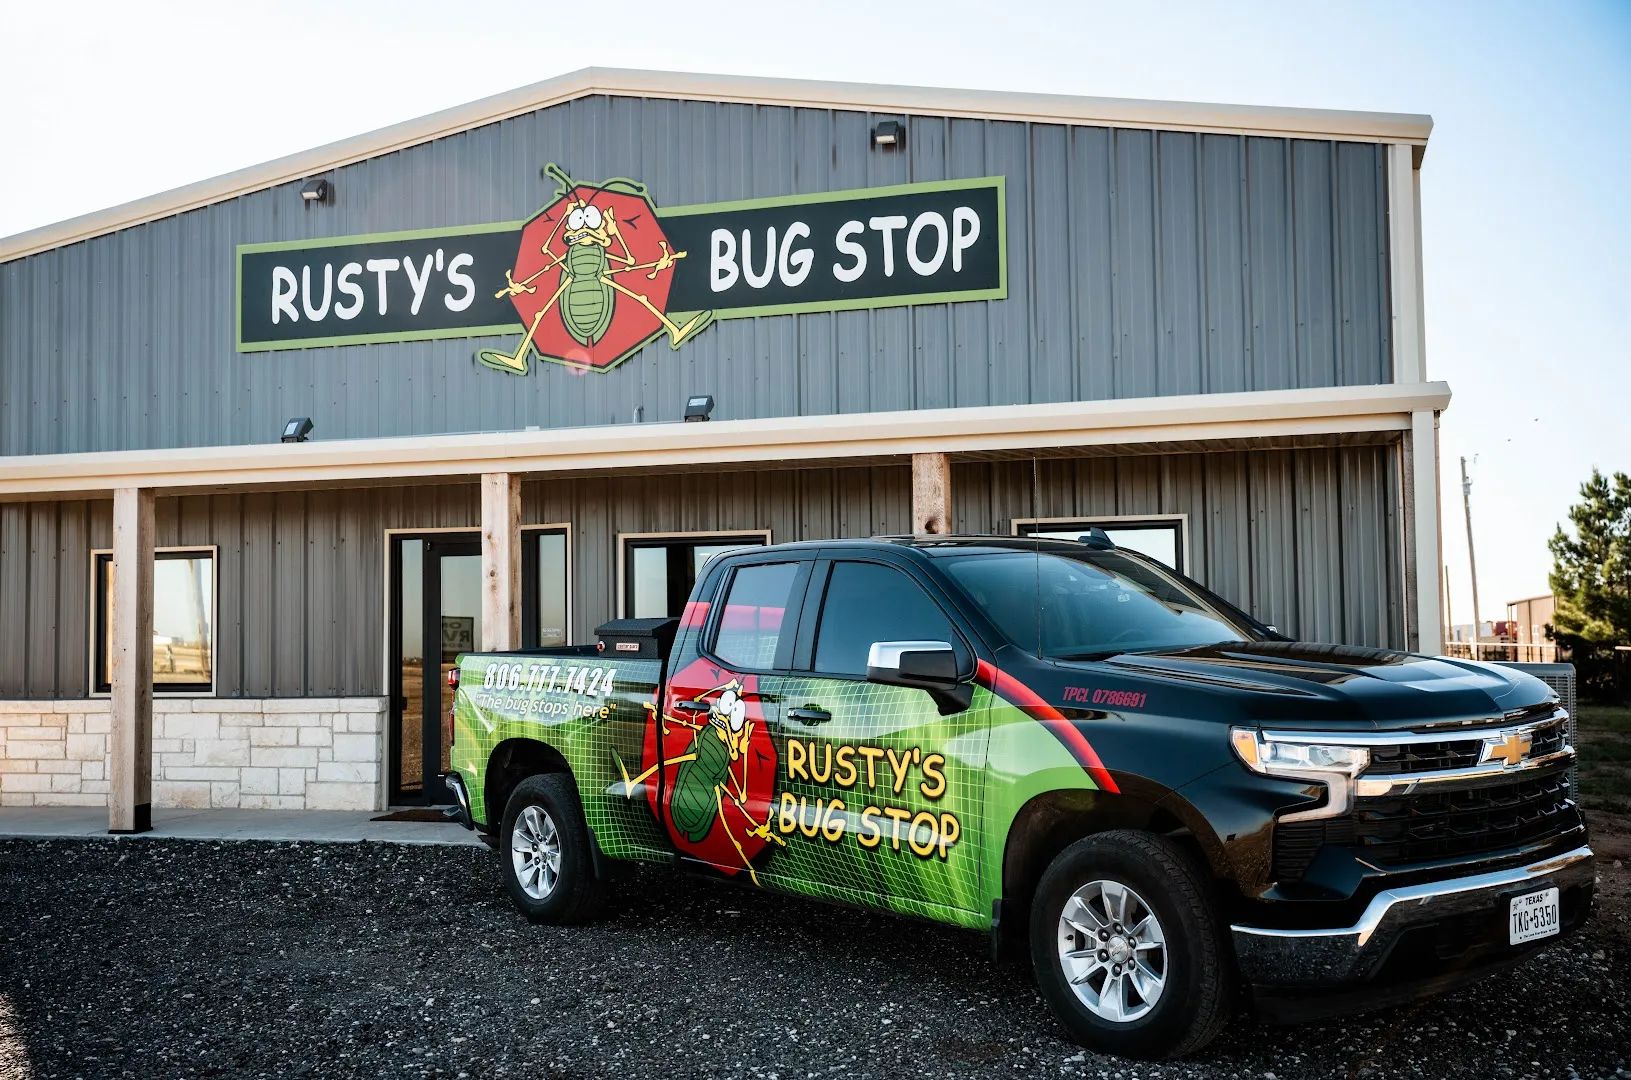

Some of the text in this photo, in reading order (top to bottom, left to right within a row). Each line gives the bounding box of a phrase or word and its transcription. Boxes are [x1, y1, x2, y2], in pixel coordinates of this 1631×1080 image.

[272, 206, 981, 325] RUSTY'S BUG STOP
[483, 663, 617, 697] 806.777.7424
[1062, 686, 1147, 708] TPCL 0786691
[504, 695, 529, 714] bug
[531, 700, 568, 717] stops
[573, 701, 617, 719] here"
[787, 739, 946, 798] RUSTY'S
[778, 792, 960, 859] BUG STOP
[1525, 893, 1543, 906] TEXAS
